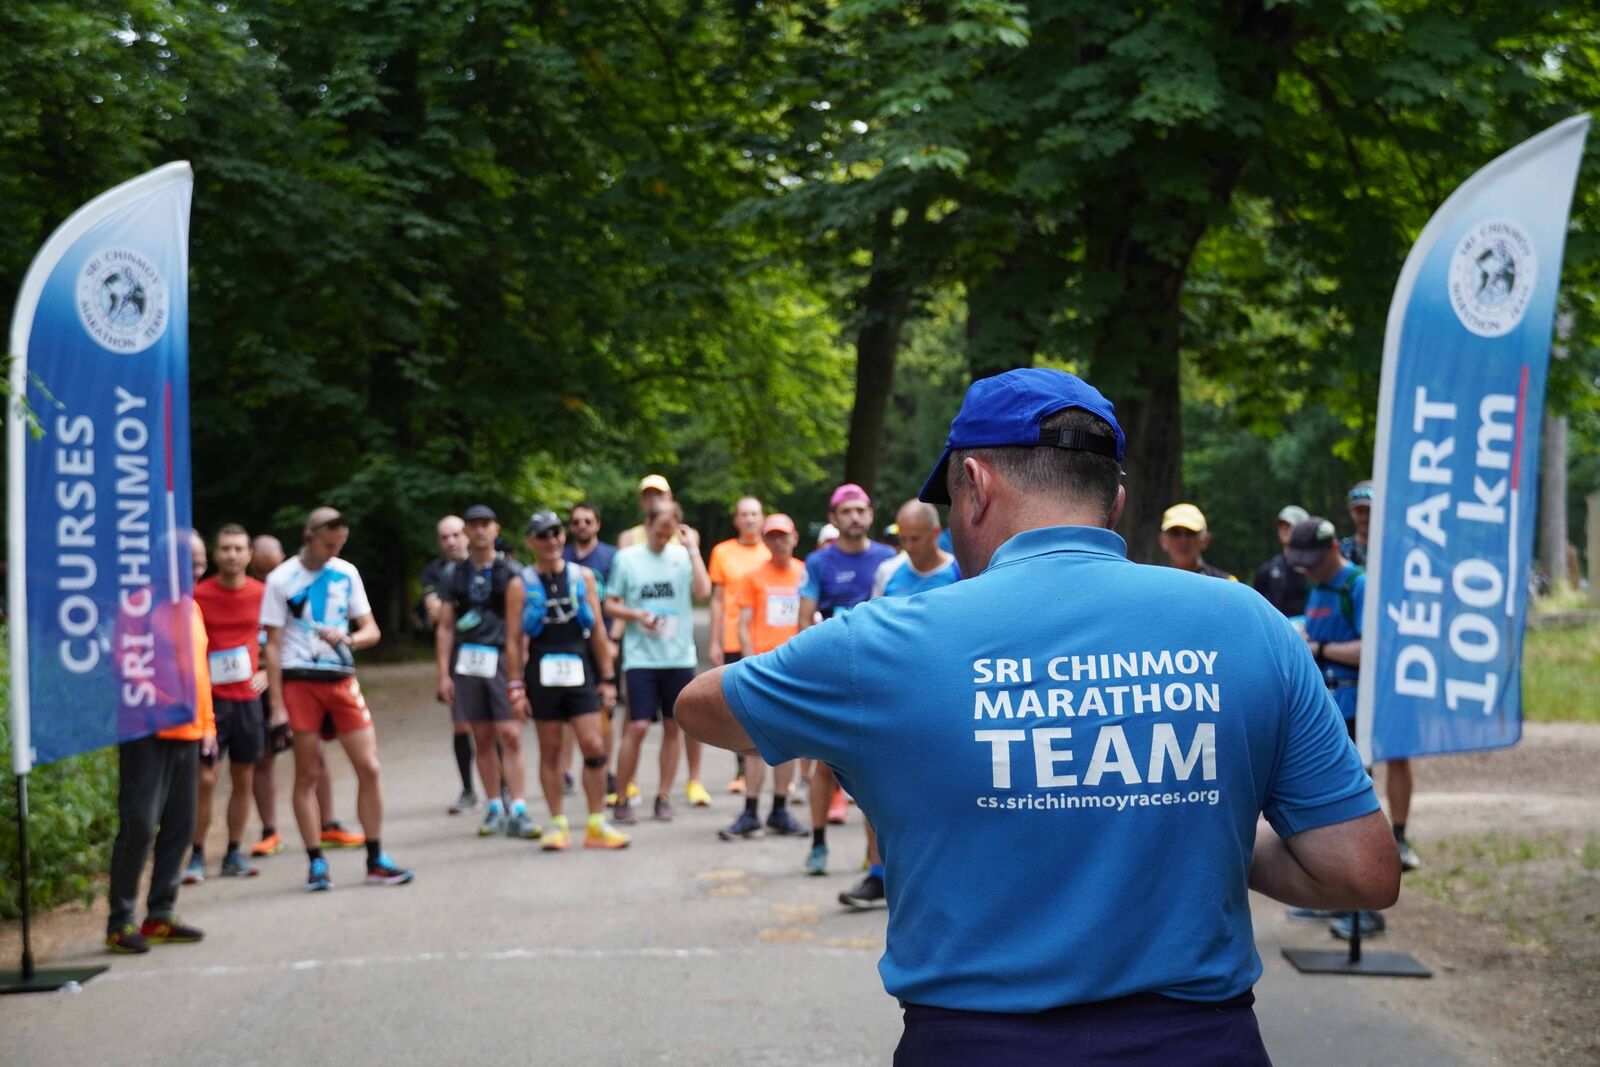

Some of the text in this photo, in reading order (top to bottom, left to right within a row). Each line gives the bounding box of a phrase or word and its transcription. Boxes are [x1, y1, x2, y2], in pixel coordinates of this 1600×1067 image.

[104, 249, 158, 284] CHINMOY
[81, 301, 137, 348] MARATHON
[56, 414, 99, 674] COURSES
[114, 384, 156, 708] SRI CHINMOY
[1387, 385, 1457, 699] DÉPART
[1445, 393, 1516, 715] 100 km
[973, 649, 1218, 683] SRI CHINMOY
[974, 682, 1220, 720] MARATHON
[974, 722, 1217, 789] TEAM
[976, 789, 1220, 811] cs.srichinmoyraces.org
